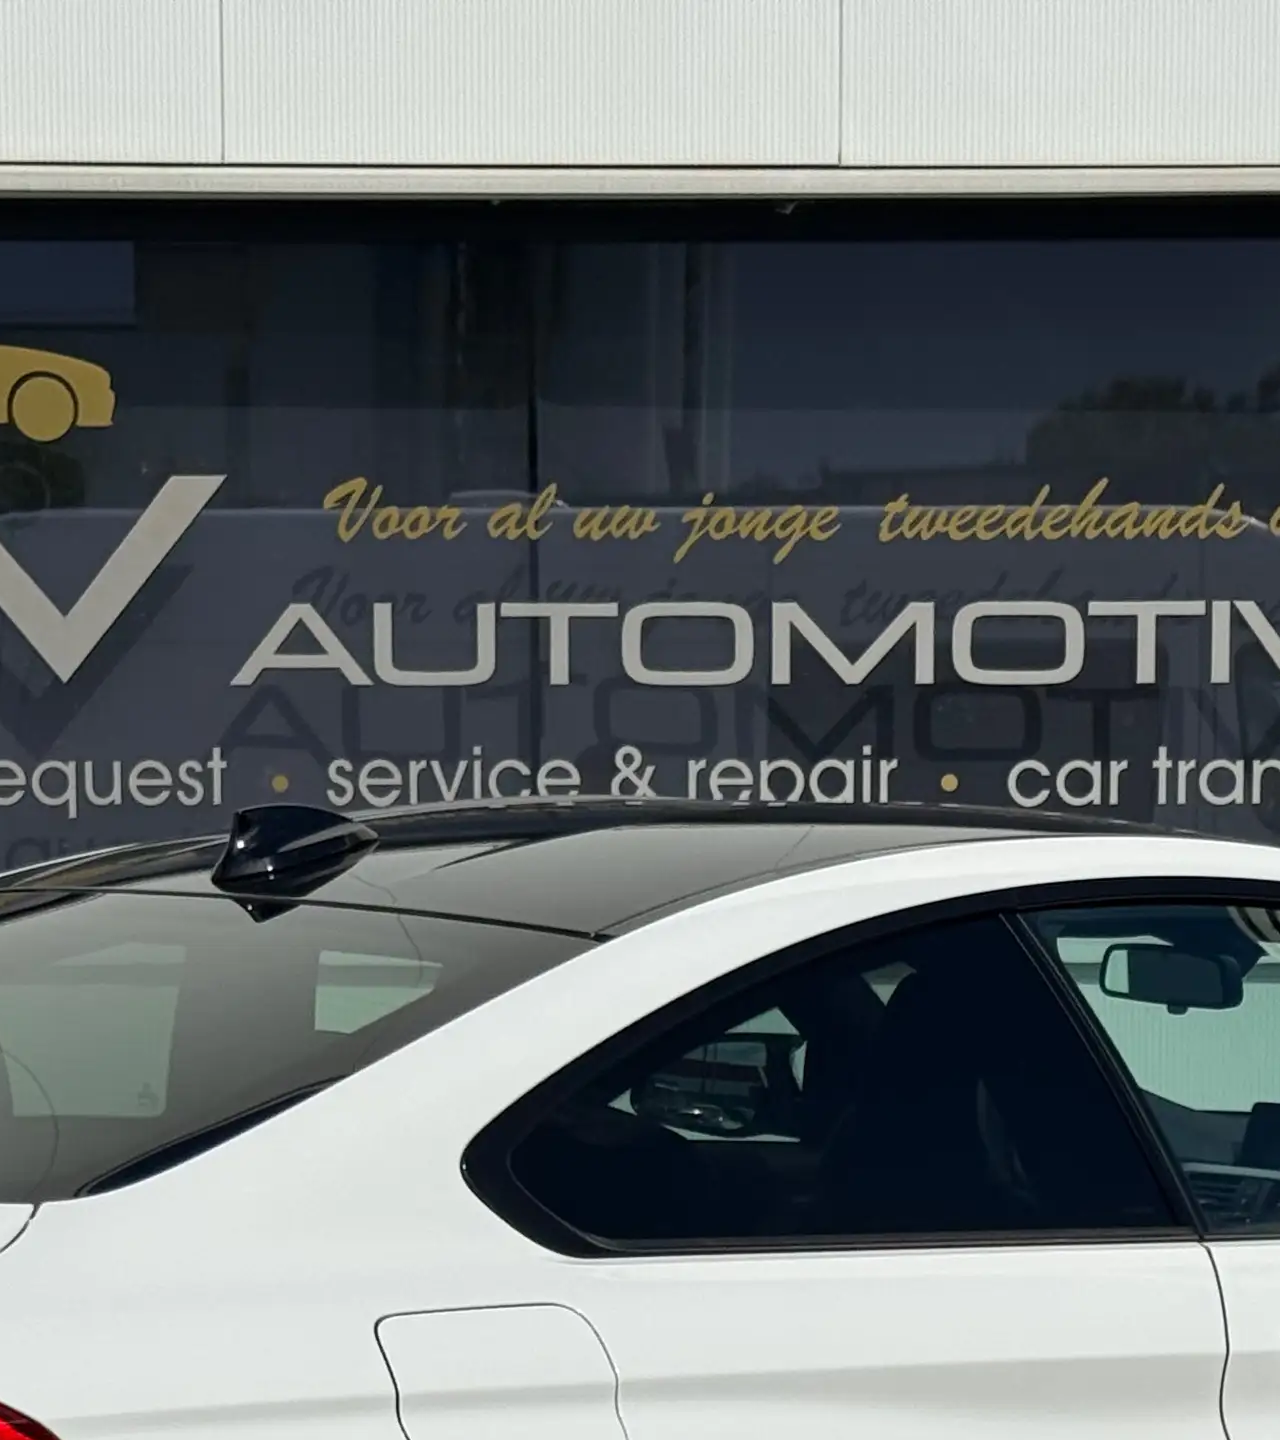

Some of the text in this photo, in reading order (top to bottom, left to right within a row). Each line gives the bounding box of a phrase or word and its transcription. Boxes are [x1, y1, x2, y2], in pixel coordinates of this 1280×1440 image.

[323, 477, 466, 543] Voor
[487, 483, 558, 542] al
[572, 504, 661, 542] uw
[673, 490, 840, 564] jonge
[878, 476, 1250, 543] tweedehands
[325, 744, 581, 806] service
[609, 745, 657, 802] &
[687, 744, 898, 805] repair
[1007, 757, 1129, 807] car
